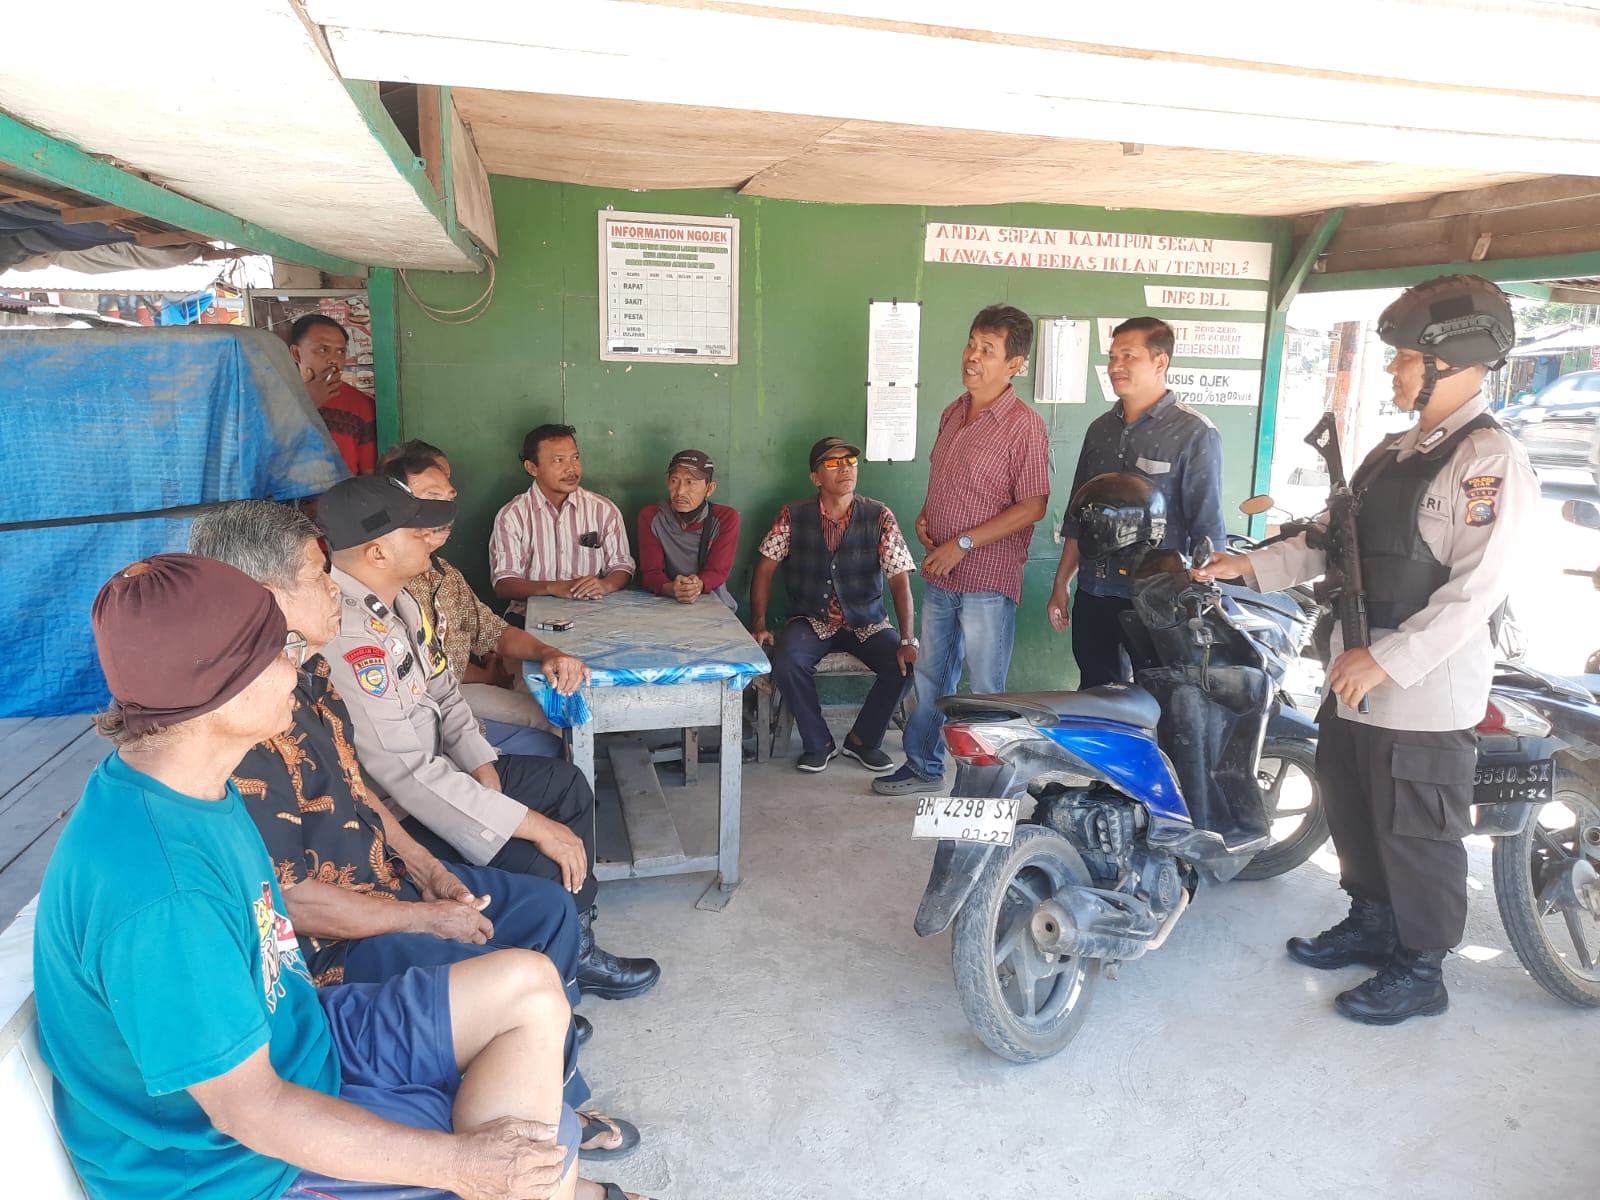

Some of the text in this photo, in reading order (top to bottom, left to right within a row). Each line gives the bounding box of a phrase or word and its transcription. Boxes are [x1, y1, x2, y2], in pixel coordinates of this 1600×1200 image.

[611, 225, 728, 242] INFORMATION NGOJEK
[935, 224, 991, 241] ANDA
[997, 227, 1058, 245] SOPAN
[1157, 236, 1215, 253] SEGAN
[938, 247, 1032, 267] KAWASAN
[1037, 253, 1098, 271] BEBAS
[1103, 257, 1158, 273] IKLAN
[623, 282, 644, 290] RAPAT
[624, 298, 643, 306] SAKIT
[1161, 290, 1230, 307] INFO DLL
[623, 313, 644, 321] PESTA
[1175, 343, 1240, 356] EBERSIHAN
[1166, 374, 1230, 388] USUS OJEK
[916, 798, 1017, 820] BM 4298 SX
